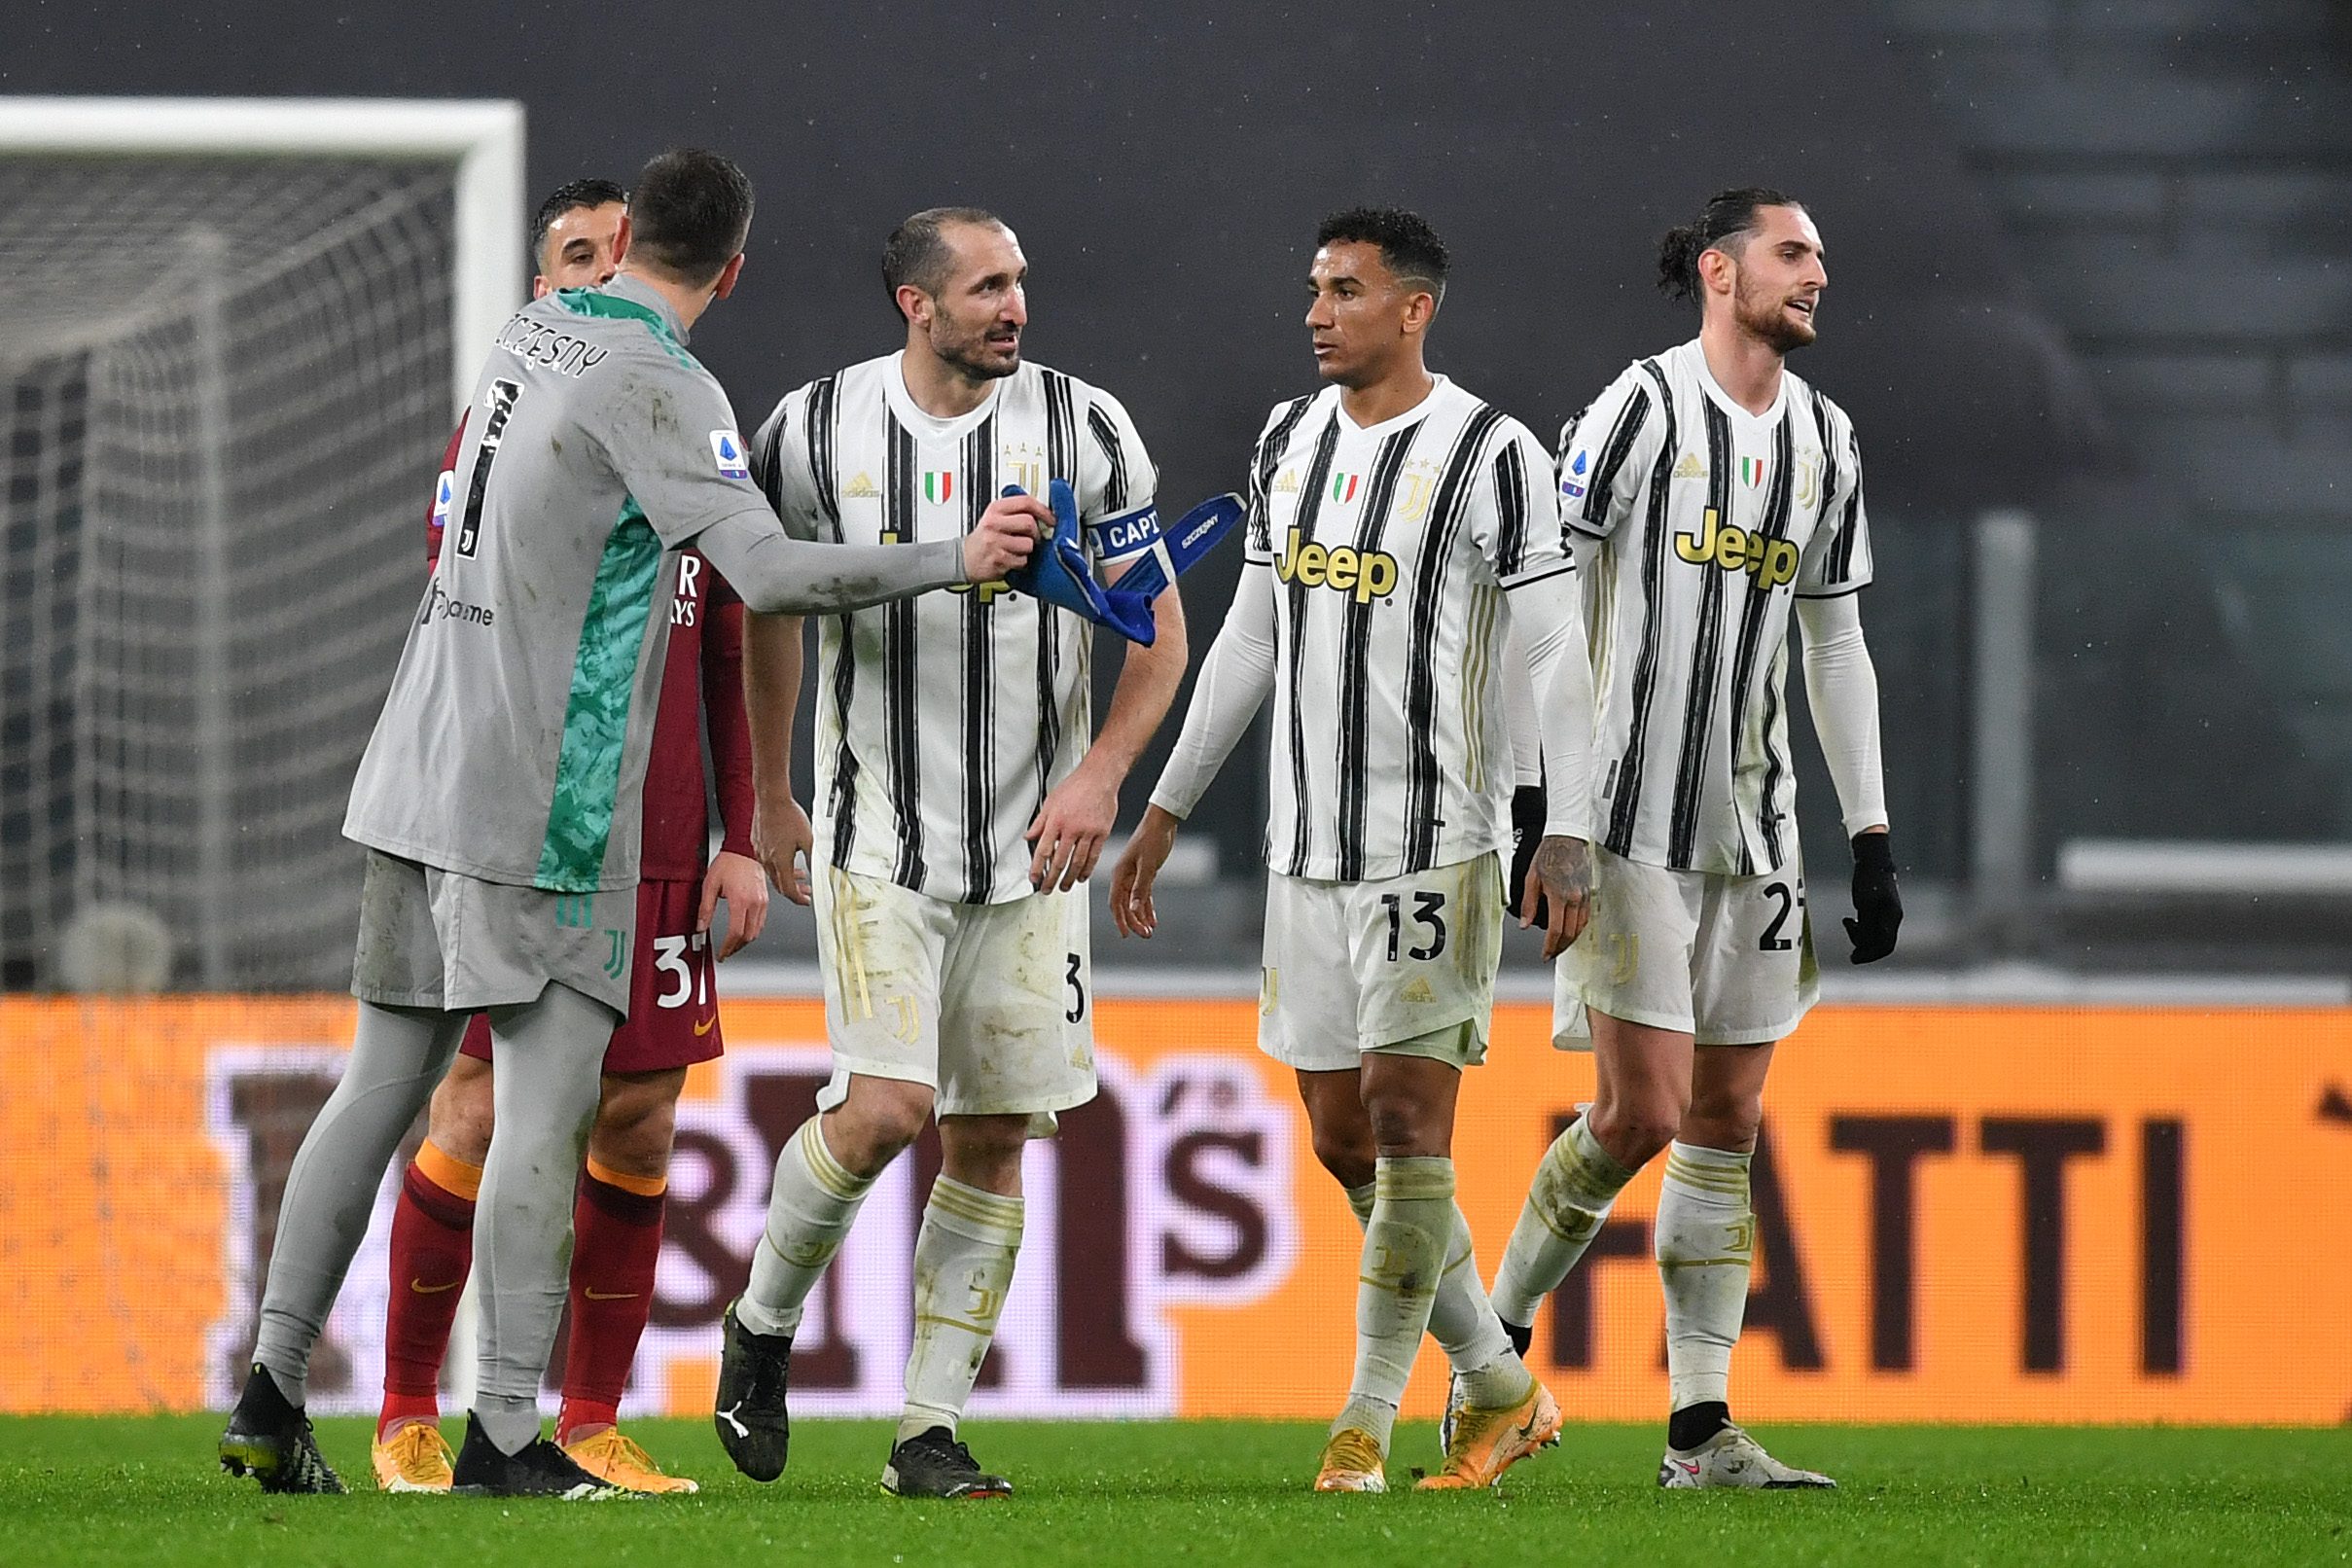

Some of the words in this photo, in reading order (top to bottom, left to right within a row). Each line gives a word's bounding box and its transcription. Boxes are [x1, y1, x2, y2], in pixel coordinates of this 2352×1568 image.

[1273, 524, 1399, 604] Jeep
[1674, 505, 1800, 592] Jeep
[1381, 891, 1445, 962] 13
[1760, 878, 1804, 950] 2
[1066, 952, 1085, 1023] 3
